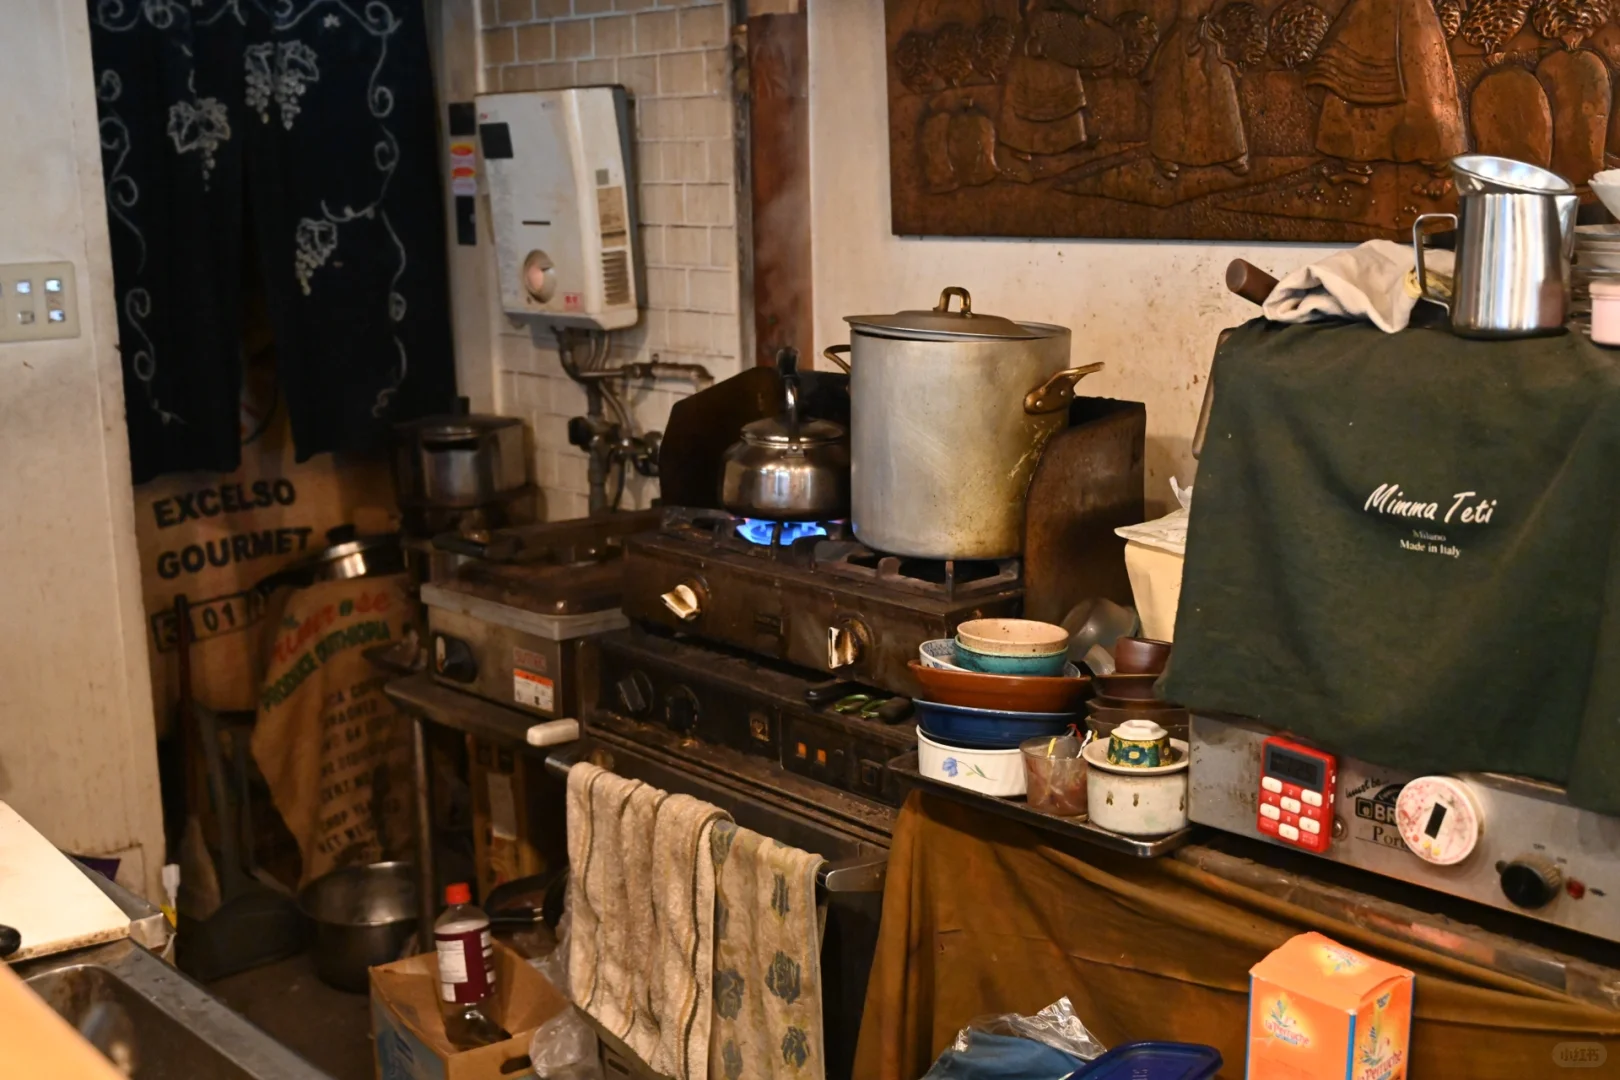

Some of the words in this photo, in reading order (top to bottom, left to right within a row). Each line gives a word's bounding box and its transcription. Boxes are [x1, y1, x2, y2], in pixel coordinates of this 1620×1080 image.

[153, 479, 296, 529] EXCELSO
[1364, 483, 1438, 520] Mimma
[1444, 491, 1497, 523] Teti
[157, 527, 312, 580] GOURMET
[1400, 539, 1425, 552] Made
[1428, 542, 1437, 554] in
[1440, 544, 1461, 558] Italy
[202, 602, 235, 632] 01
